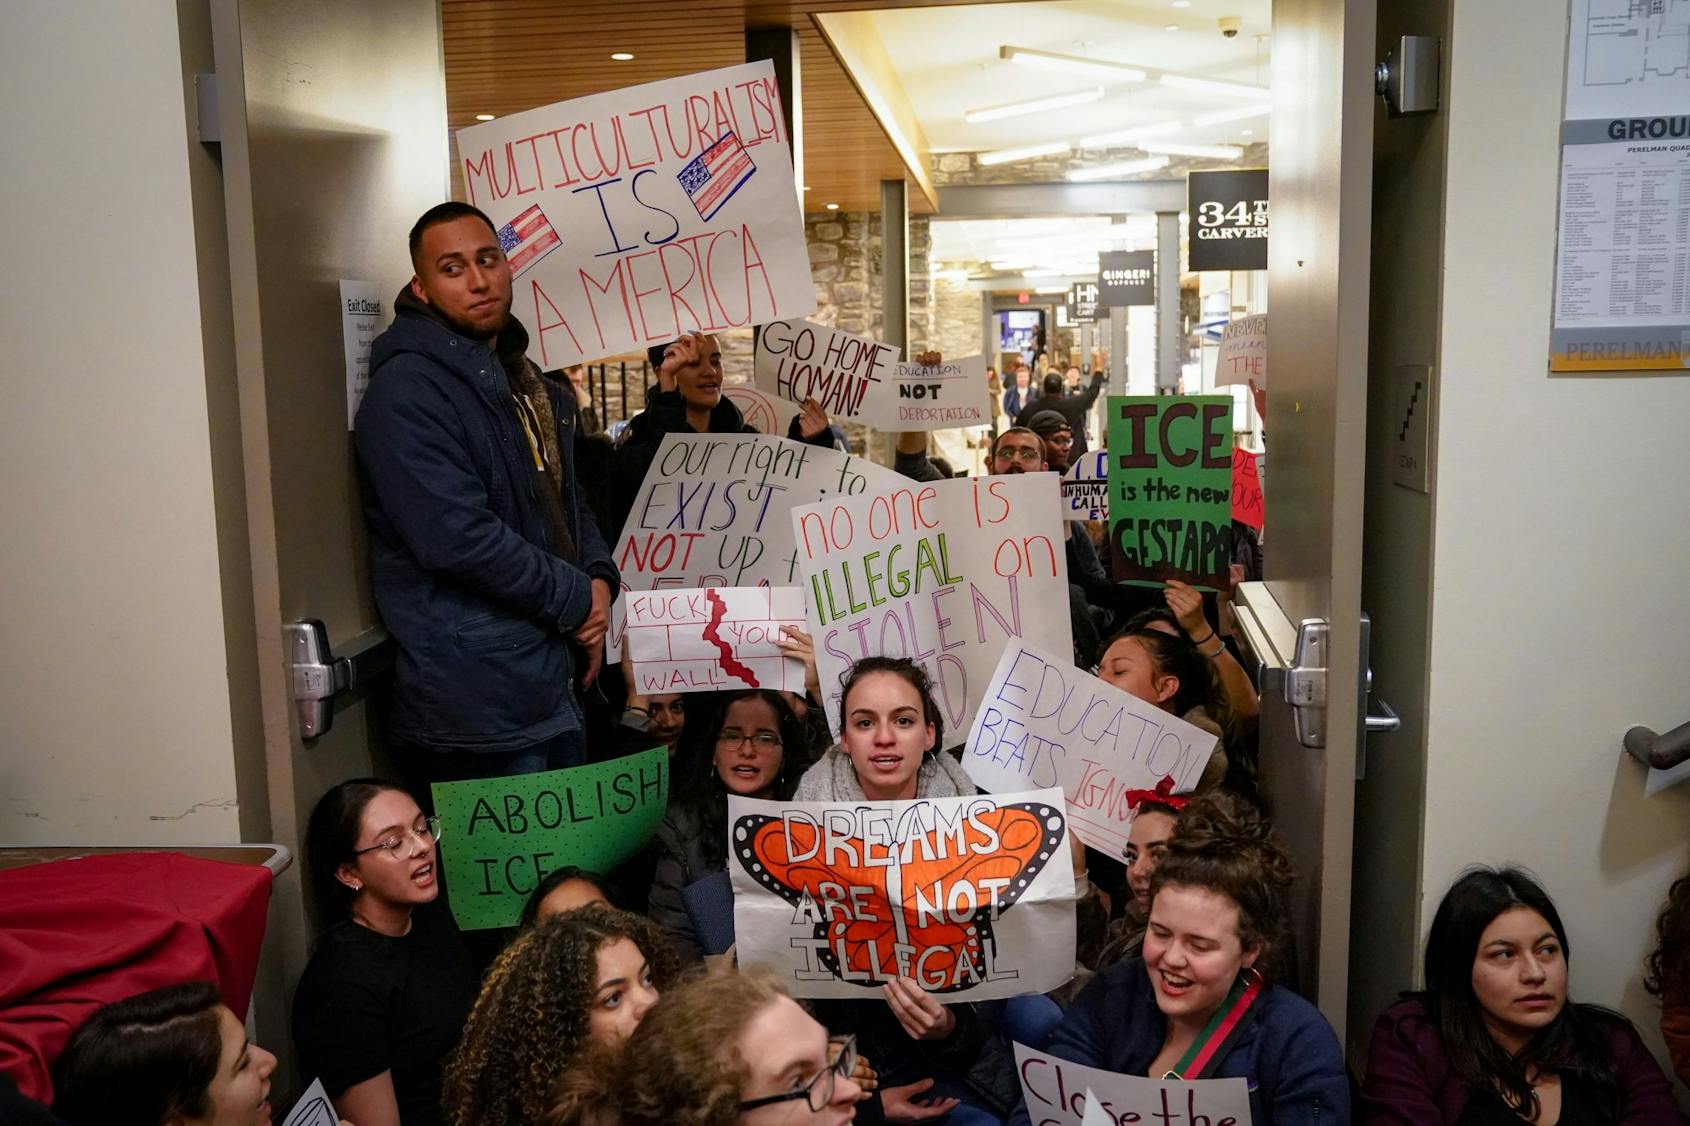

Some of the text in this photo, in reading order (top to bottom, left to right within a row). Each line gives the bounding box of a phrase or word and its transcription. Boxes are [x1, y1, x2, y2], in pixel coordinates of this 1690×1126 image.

[465, 75, 790, 207] MULTICULTURALISM
[1608, 117, 1690, 140] GROU
[571, 169, 680, 257] IS
[1197, 201, 1252, 227] 34
[1197, 227, 1269, 240] CARVER
[347, 299, 380, 313] Exit Closed
[531, 223, 778, 367] AMERICA
[762, 321, 892, 382] GO HOME
[1228, 355, 1263, 375] THE
[1566, 341, 1683, 361] PERELMAN
[777, 358, 868, 417] HOMAN!
[899, 383, 942, 400] NOT
[899, 405, 980, 422] DEPORTATION
[1120, 403, 1232, 469] ICE
[728, 438, 809, 502] right
[836, 456, 867, 496] to
[1121, 478, 1229, 505] is the new
[638, 479, 787, 534] EXIST
[800, 477, 1010, 559] no one is
[1071, 496, 1108, 510] CALL
[620, 532, 705, 572] NOT
[1112, 518, 1232, 576] GESTAPO
[811, 533, 964, 627] ILLEGAL
[994, 535, 1057, 578] on
[633, 594, 708, 622] FUCK
[824, 576, 1022, 684] STOLEN
[643, 667, 728, 692] WALL
[973, 707, 1066, 789] BEATS
[997, 649, 1200, 792] EDUCATION
[468, 761, 662, 835] ABOLISH
[782, 800, 1000, 868] DREAMS
[475, 851, 555, 896] ICE
[791, 877, 1011, 929] ARE NOT
[790, 936, 1019, 991] ILLEGAL
